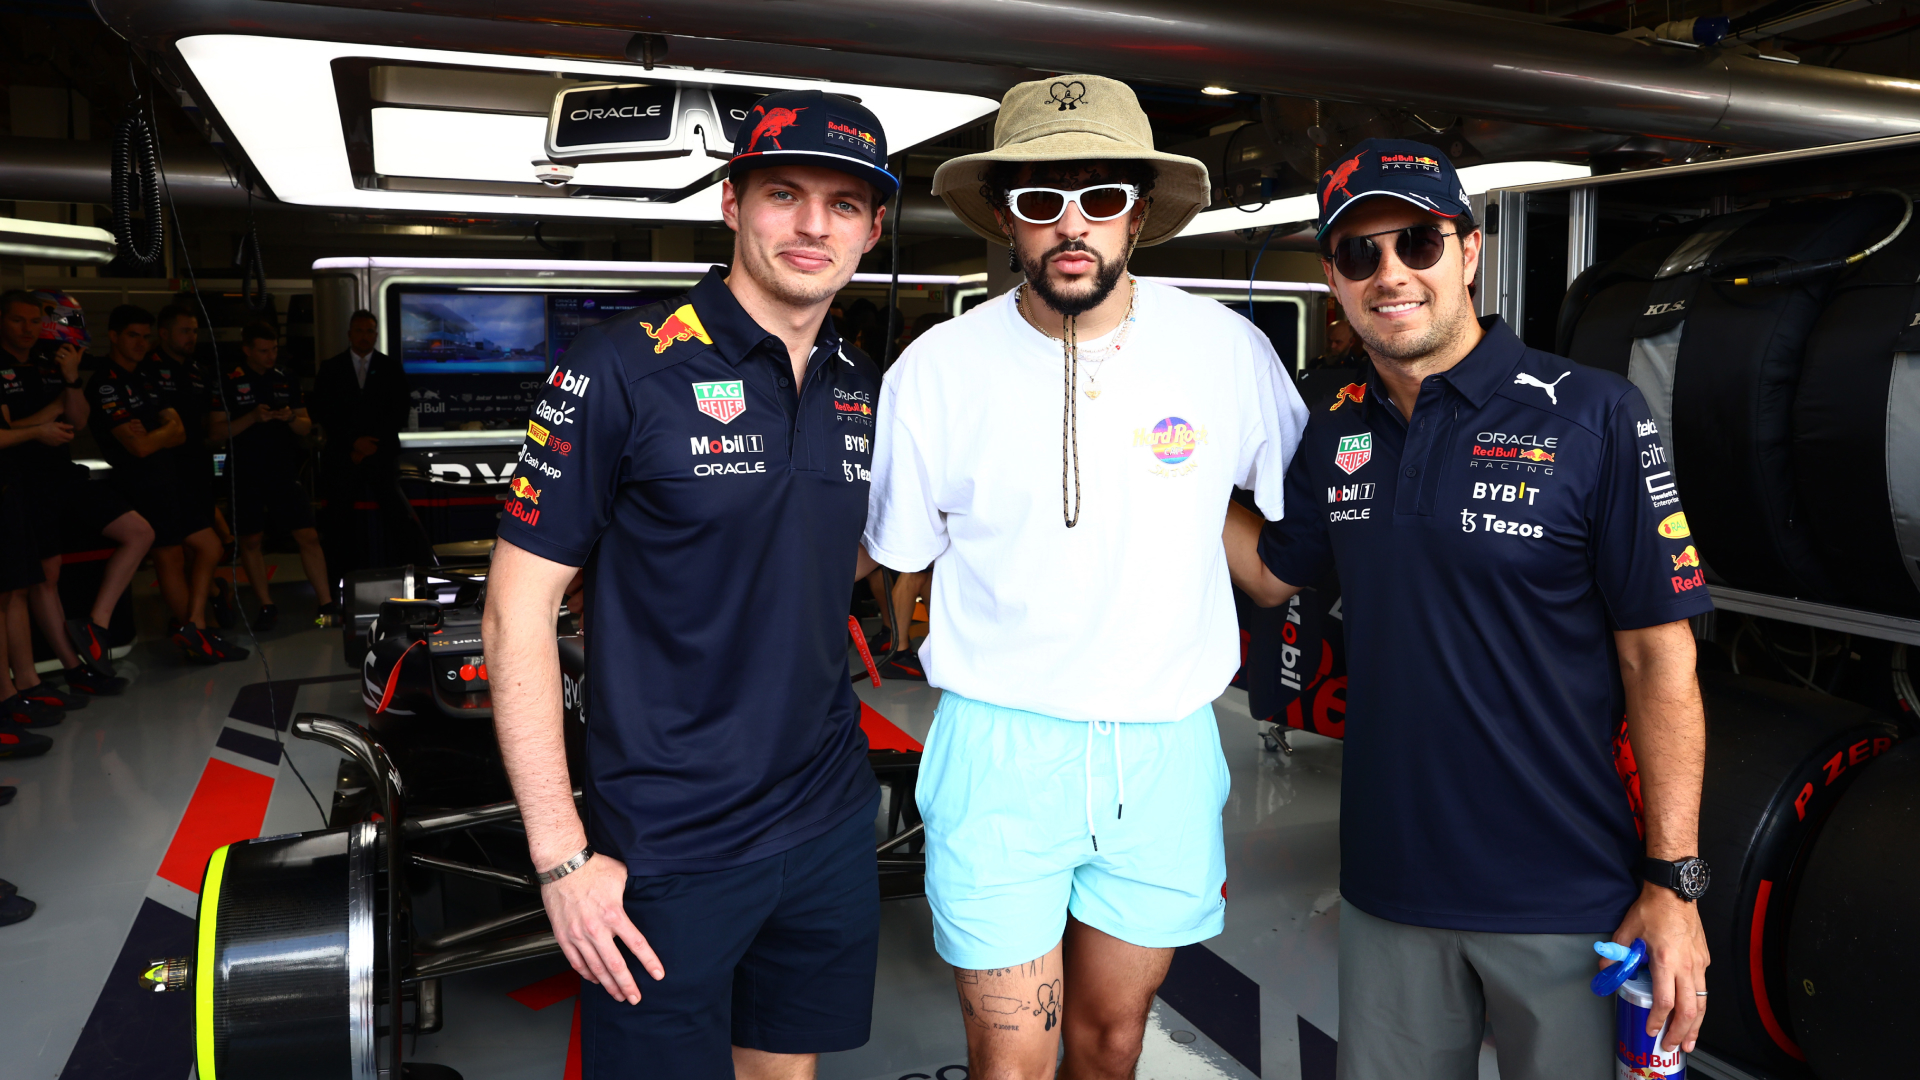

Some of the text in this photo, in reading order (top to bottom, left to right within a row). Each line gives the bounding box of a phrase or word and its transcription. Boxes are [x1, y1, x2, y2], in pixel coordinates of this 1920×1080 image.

[570, 105, 662, 121] ORACLE
[828, 121, 857, 136] Red Bull
[827, 133, 876, 154] RACING
[1398, 154, 1414, 162] Bull
[1382, 164, 1440, 173] RACING
[697, 384, 740, 397] TAG
[833, 388, 870, 403] ORACLE
[700, 401, 743, 420] HEUER
[837, 415, 872, 427] RACING
[844, 433, 870, 455] BYBIT
[1132, 423, 1208, 448] Hard Rock
[1342, 436, 1370, 451] TAG
[1476, 432, 1558, 448] ORACLE
[690, 435, 745, 455] Mobil
[1164, 446, 1185, 456] CAFE
[1473, 445, 1518, 458] Red Bull
[524, 452, 562, 479] Cash App
[694, 461, 767, 477] ORACLE
[1337, 451, 1369, 471] HEUER
[1470, 461, 1554, 476] RACING
[1327, 484, 1359, 504] Mobil
[1472, 482, 1540, 505] BYBIT
[511, 500, 541, 527] Bull
[1329, 508, 1371, 522] ORACLE
[1482, 513, 1544, 539] Tezos
[1281, 594, 1301, 691] Mobil
[1793, 737, 1892, 822] P ZER
[1619, 1040, 1680, 1068] Red Bull
